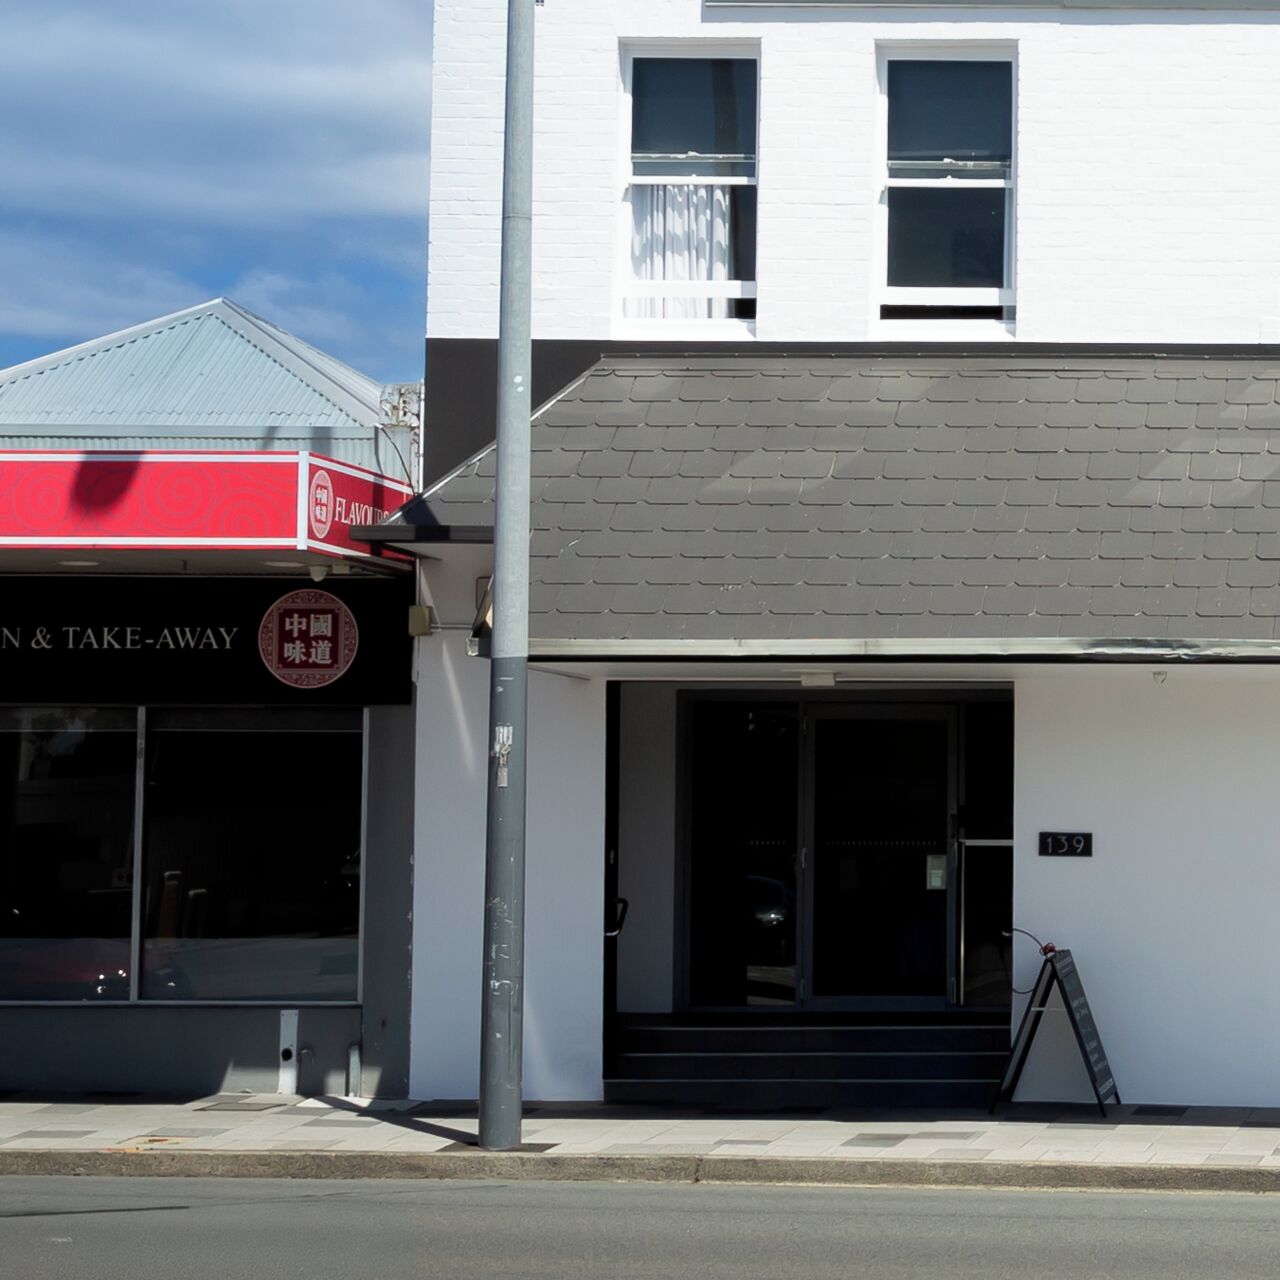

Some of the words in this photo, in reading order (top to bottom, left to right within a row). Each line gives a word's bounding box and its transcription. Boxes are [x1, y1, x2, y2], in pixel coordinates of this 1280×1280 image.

[31, 626, 54, 650] &
[62, 626, 239, 650] TAKE-AWAY
[1046, 836, 1084, 853] 139
